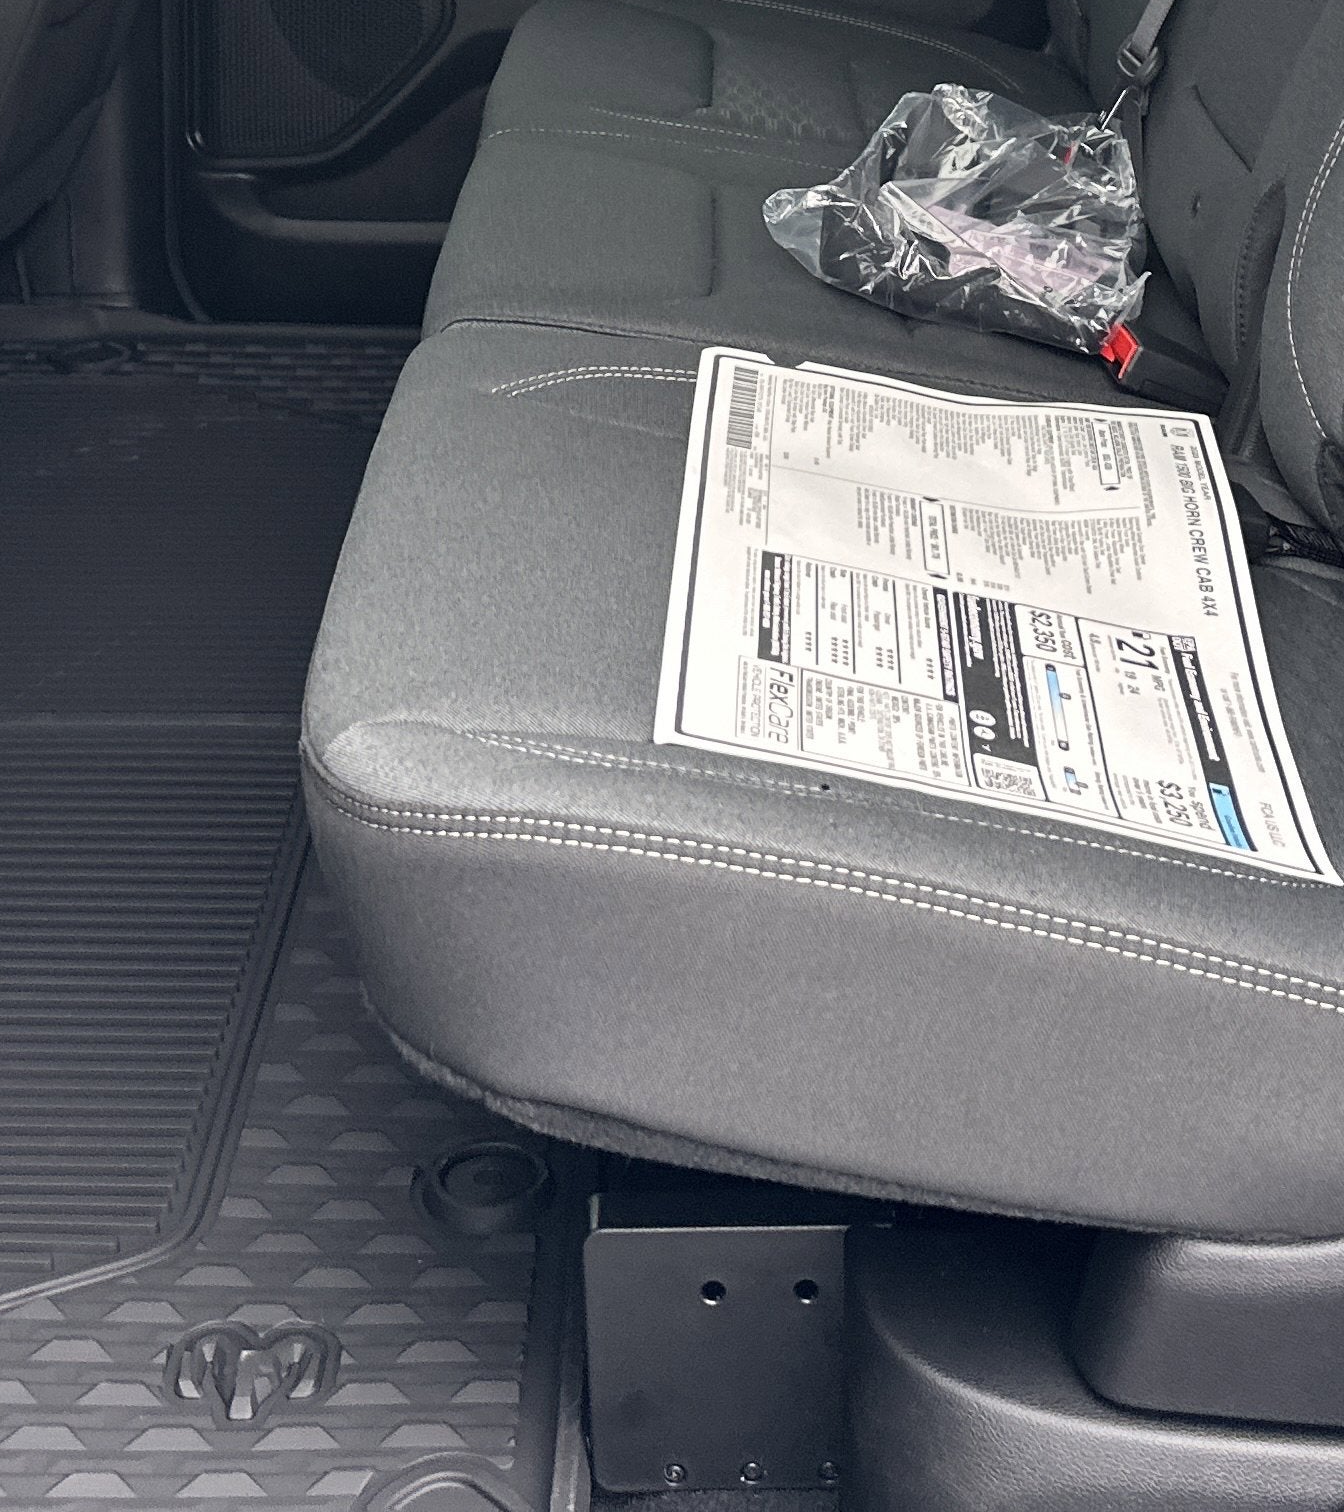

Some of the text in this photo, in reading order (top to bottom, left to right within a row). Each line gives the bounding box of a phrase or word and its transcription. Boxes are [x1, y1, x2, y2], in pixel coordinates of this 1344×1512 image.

[1169, 443, 1187, 462] RAM
[1178, 478, 1195, 495] BIG
[1198, 481, 1212, 501] YEAR
[1181, 494, 1202, 527] HORN
[1187, 527, 1210, 564] CREW
[1194, 566, 1215, 594] CAB
[1199, 594, 1219, 618] 4X4
[1028, 609, 1058, 653] $2,350
[1114, 637, 1160, 671] 21
[766, 666, 793, 746] FlexCare
[1155, 778, 1194, 828] $3,250
[1187, 799, 1214, 831] spend
[1258, 801, 1276, 821] FCA
[1268, 832, 1286, 848] LLC
